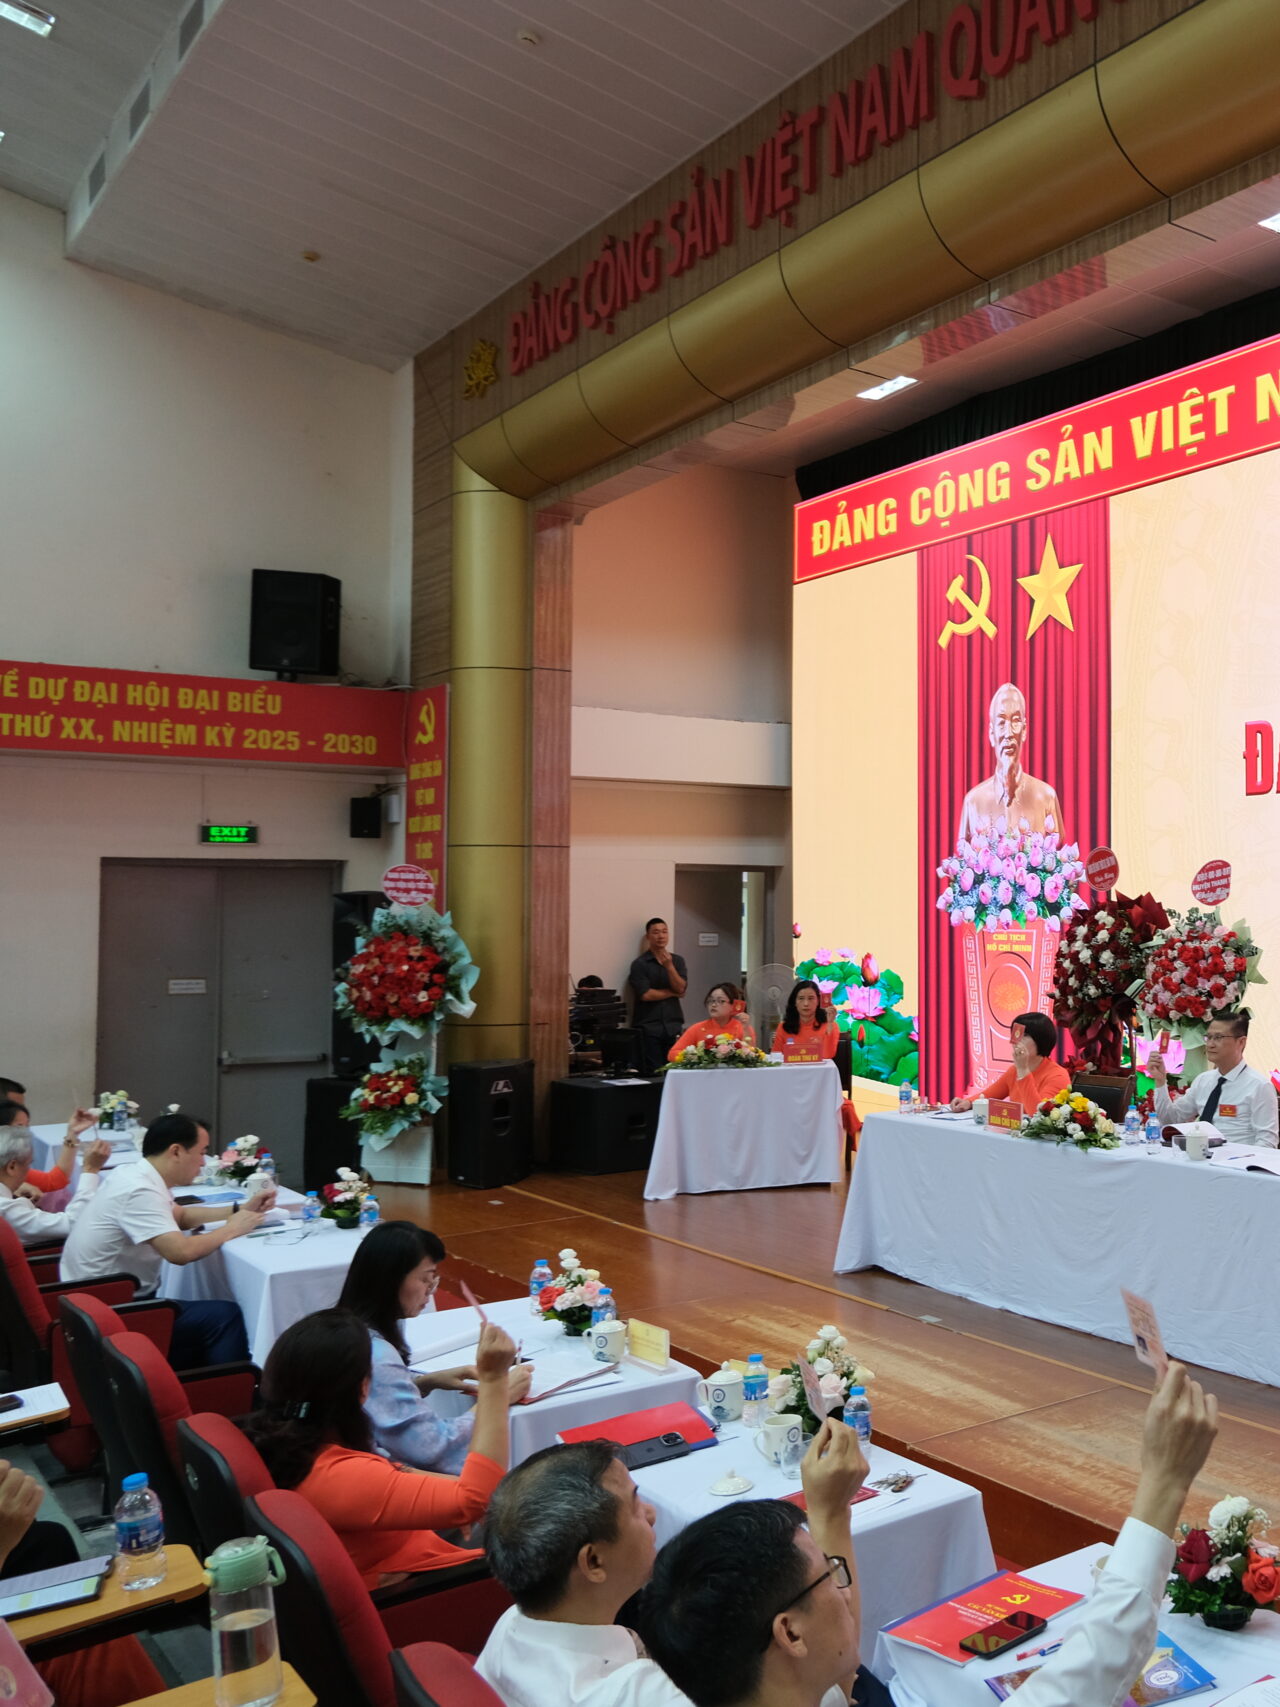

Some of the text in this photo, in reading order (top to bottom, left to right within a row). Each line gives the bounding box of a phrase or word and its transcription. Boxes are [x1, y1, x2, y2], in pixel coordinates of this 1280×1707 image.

[509, 0, 1098, 376] ĐẢNG CỘNG SẢN VIỆT NAM QUA
[811, 497, 898, 557] ĐẢNG
[910, 461, 1011, 528] CỘNG
[1025, 425, 1113, 492] SẢN
[1129, 385, 1236, 459] VIỆT
[0, 668, 282, 715] Ề DỰ ĐẠI HỘI ĐẠI BIỂU
[0, 711, 55, 738] THỨ
[60, 716, 104, 742] XX,
[112, 719, 197, 748] NHIỆM
[204, 722, 236, 748] KỲ
[242, 727, 300, 751] 2025
[322, 732, 378, 755] 2030
[209, 826, 249, 837] EXIT
